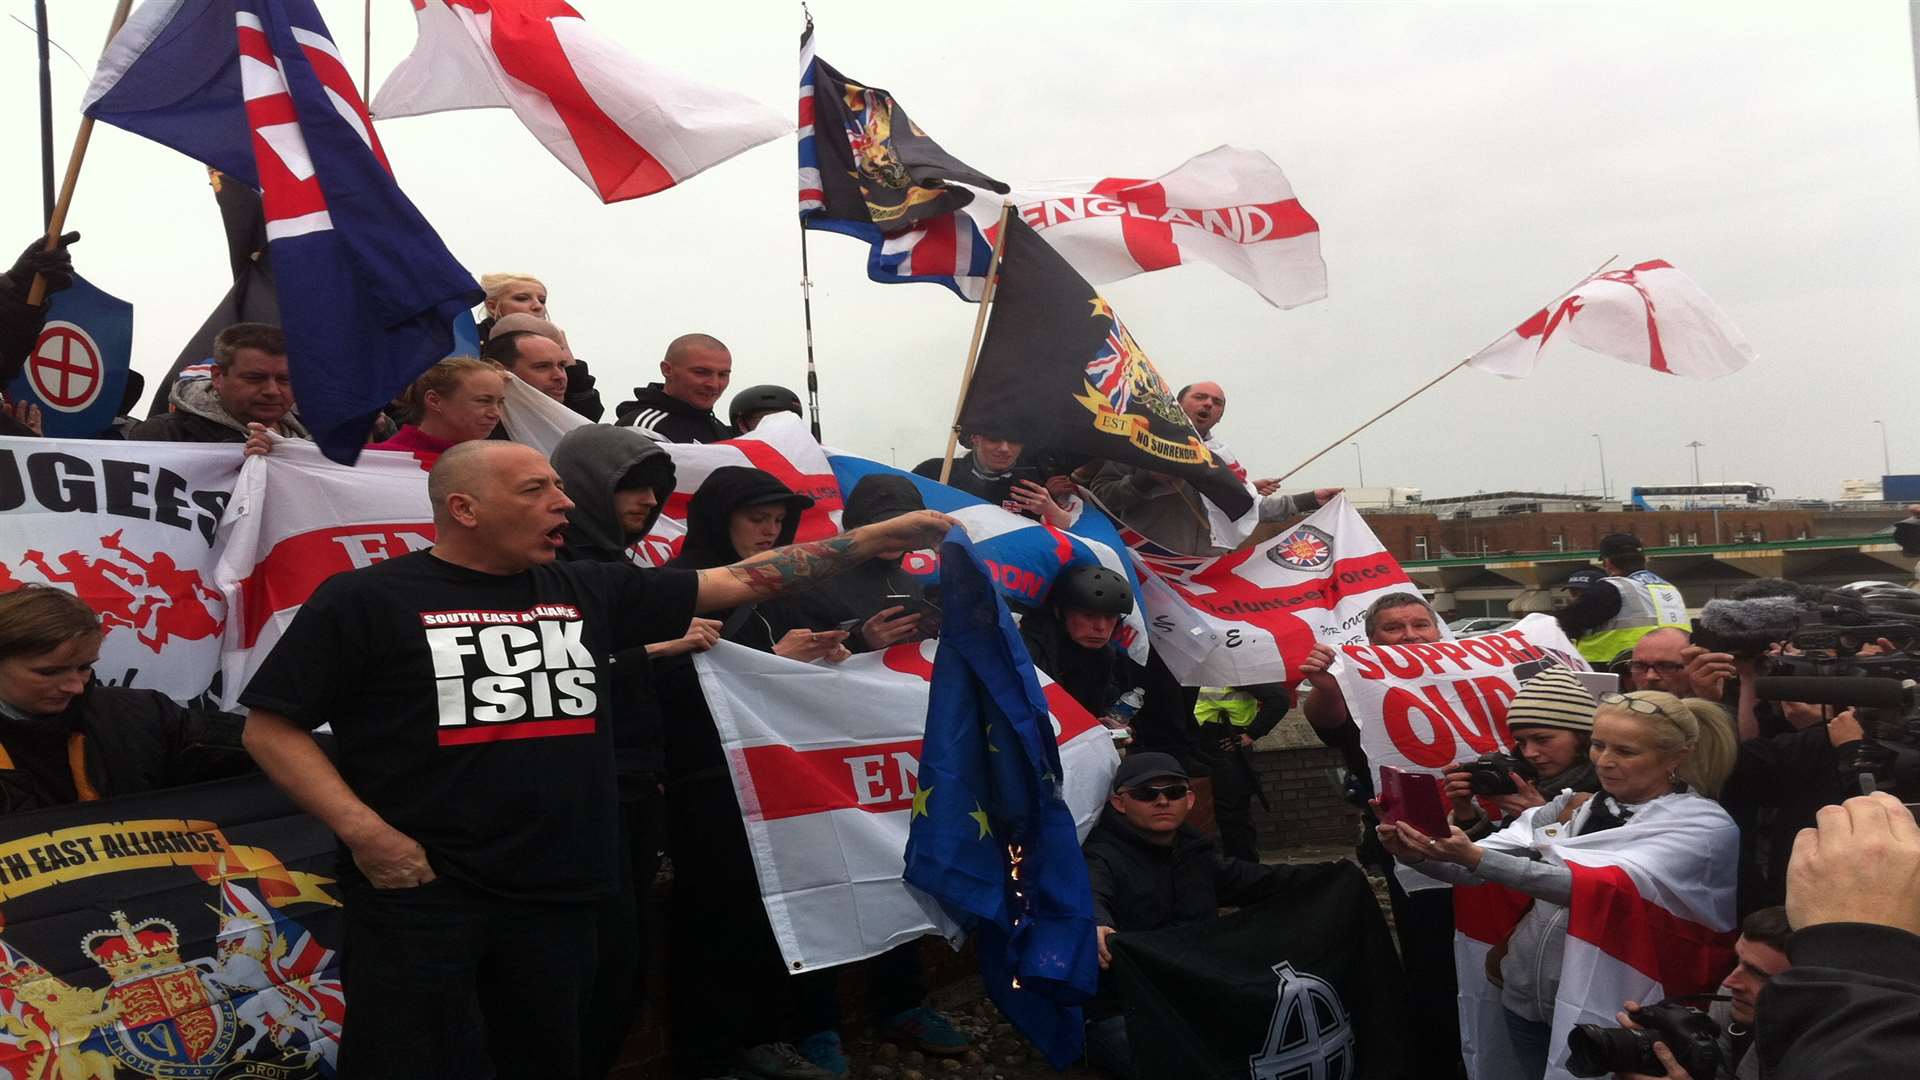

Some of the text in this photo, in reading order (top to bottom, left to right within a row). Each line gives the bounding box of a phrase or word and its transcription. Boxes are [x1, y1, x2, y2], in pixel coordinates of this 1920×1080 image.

[1018, 197, 1274, 244] ENGLAND
[1101, 416, 1128, 431] EST
[1136, 430, 1198, 460] NO SURRENDER
[424, 612, 480, 625] SOUTH
[482, 612, 518, 624] EAST
[425, 620, 597, 678] FCK
[1342, 629, 1545, 680] SUPPORT
[436, 669, 597, 726] ISIS
[28, 836, 99, 873] EAST
[100, 831, 225, 859] ALLIANCE
[244, 1064, 291, 1080] DROIT
